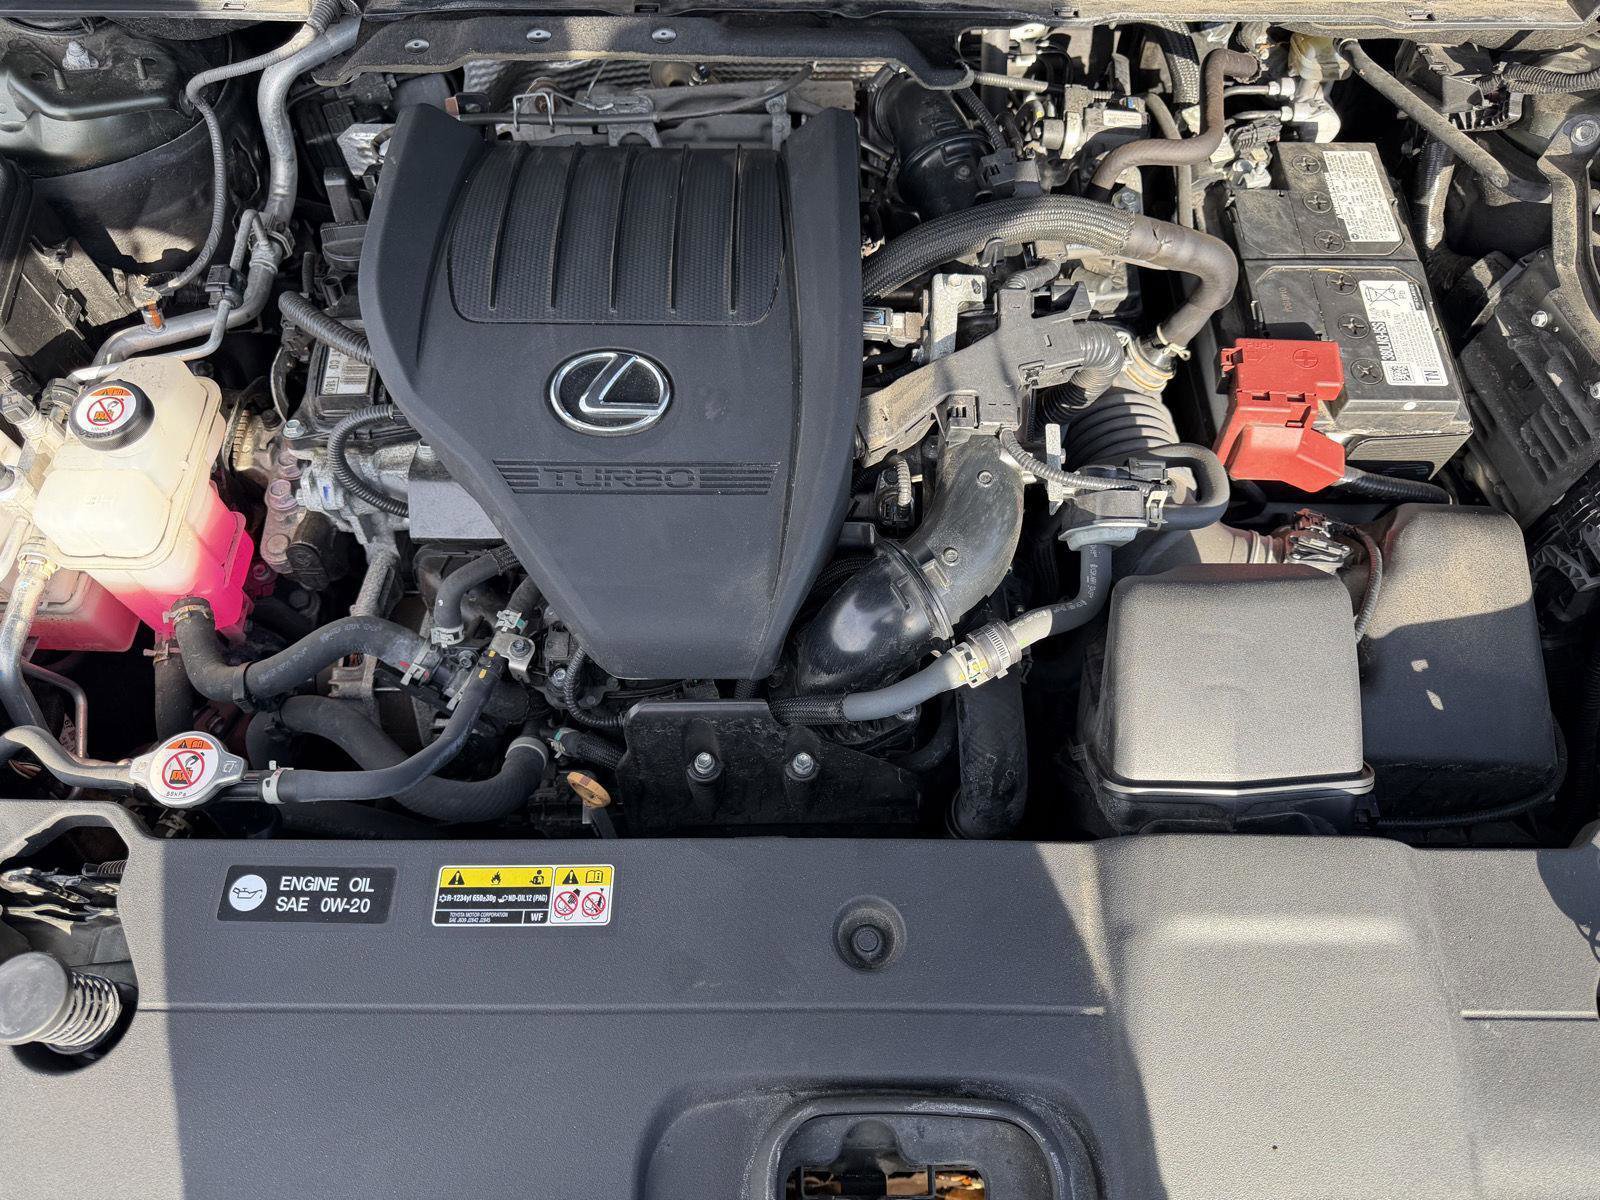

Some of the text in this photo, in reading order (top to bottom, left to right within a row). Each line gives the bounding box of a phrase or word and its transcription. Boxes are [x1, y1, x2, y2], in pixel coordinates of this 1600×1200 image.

[1424, 370, 1440, 382] TN
[543, 468, 696, 488] TURBO
[279, 876, 375, 893] ENGINE OIL
[275, 897, 371, 913] SAE 0W-20
[530, 912, 544, 922] WF
